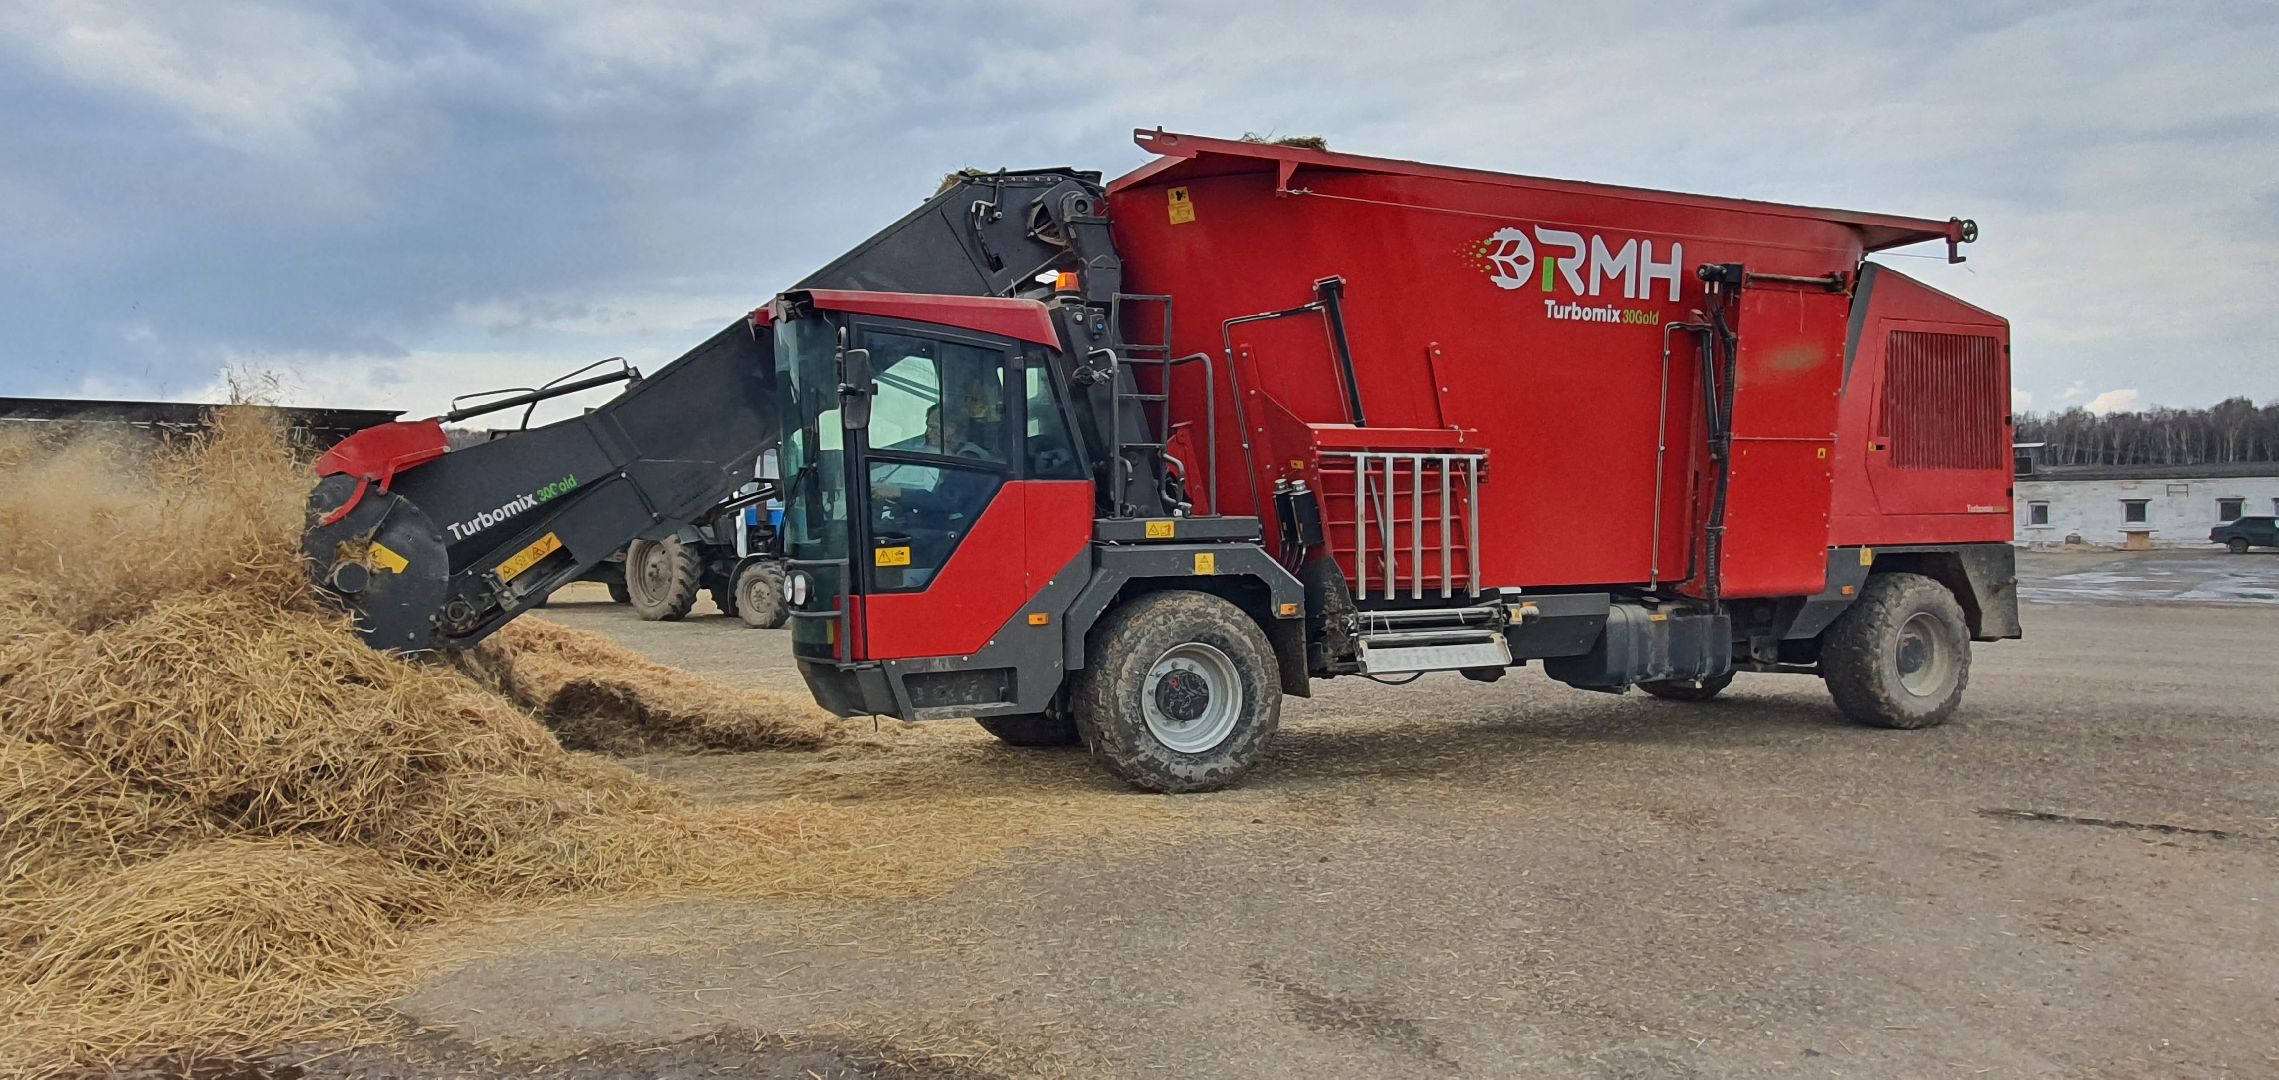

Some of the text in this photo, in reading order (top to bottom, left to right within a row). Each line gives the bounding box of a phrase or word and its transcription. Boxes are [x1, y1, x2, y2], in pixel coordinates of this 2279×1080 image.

[1534, 224, 1683, 302] RMH
[1544, 299, 1660, 326] Turbomix 30Gold
[447, 493, 538, 541] Turbomix
